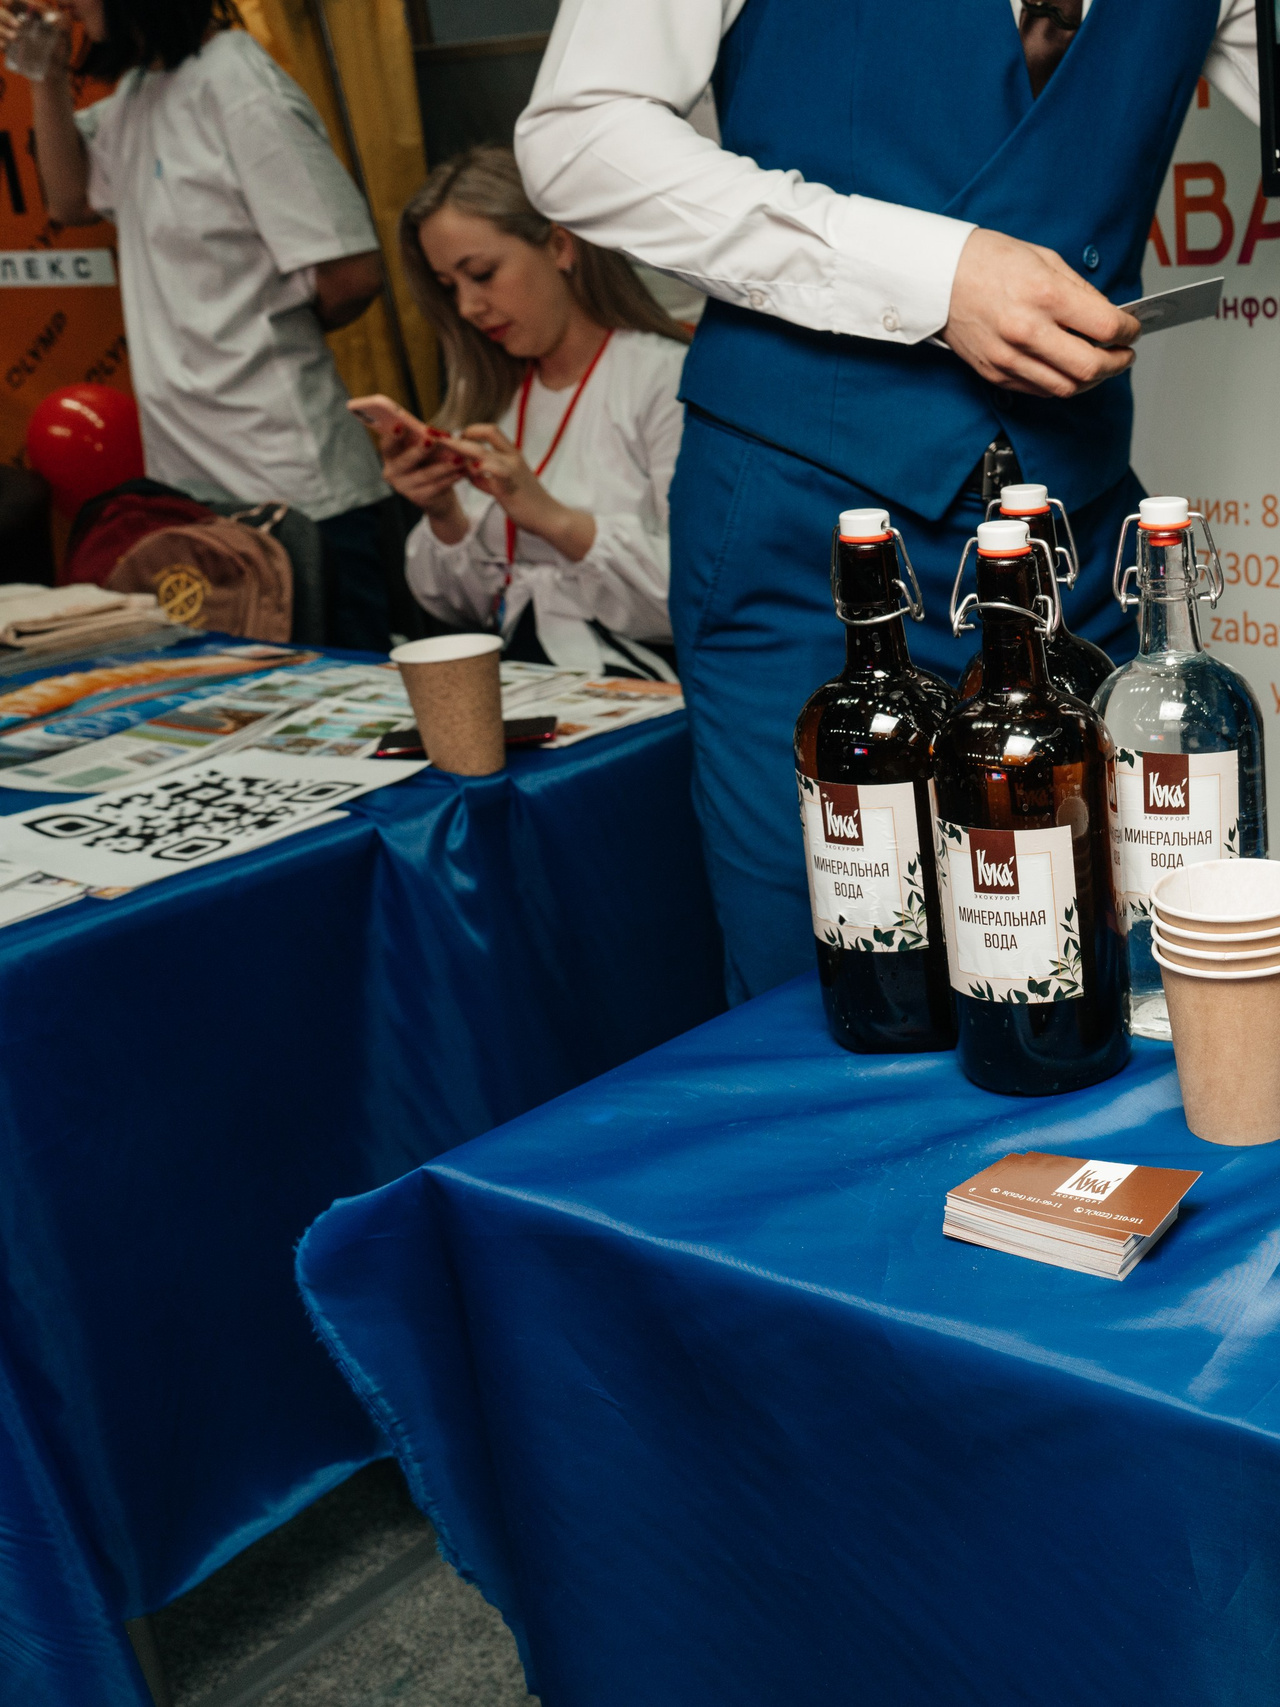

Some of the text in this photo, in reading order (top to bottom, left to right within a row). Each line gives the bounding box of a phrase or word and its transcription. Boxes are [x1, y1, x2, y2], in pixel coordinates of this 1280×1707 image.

[1124, 827, 1213, 847] МИНЕРАЛЬНАЯ
[813, 854, 890, 878] МИНЕРАЛЬНАЯ
[1150, 852, 1185, 870] ВОДА
[834, 881, 864, 900] ВОДА
[958, 905, 1047, 928] МИНЕРАЛЬНАЯ
[984, 932, 1018, 951] ВОДА
